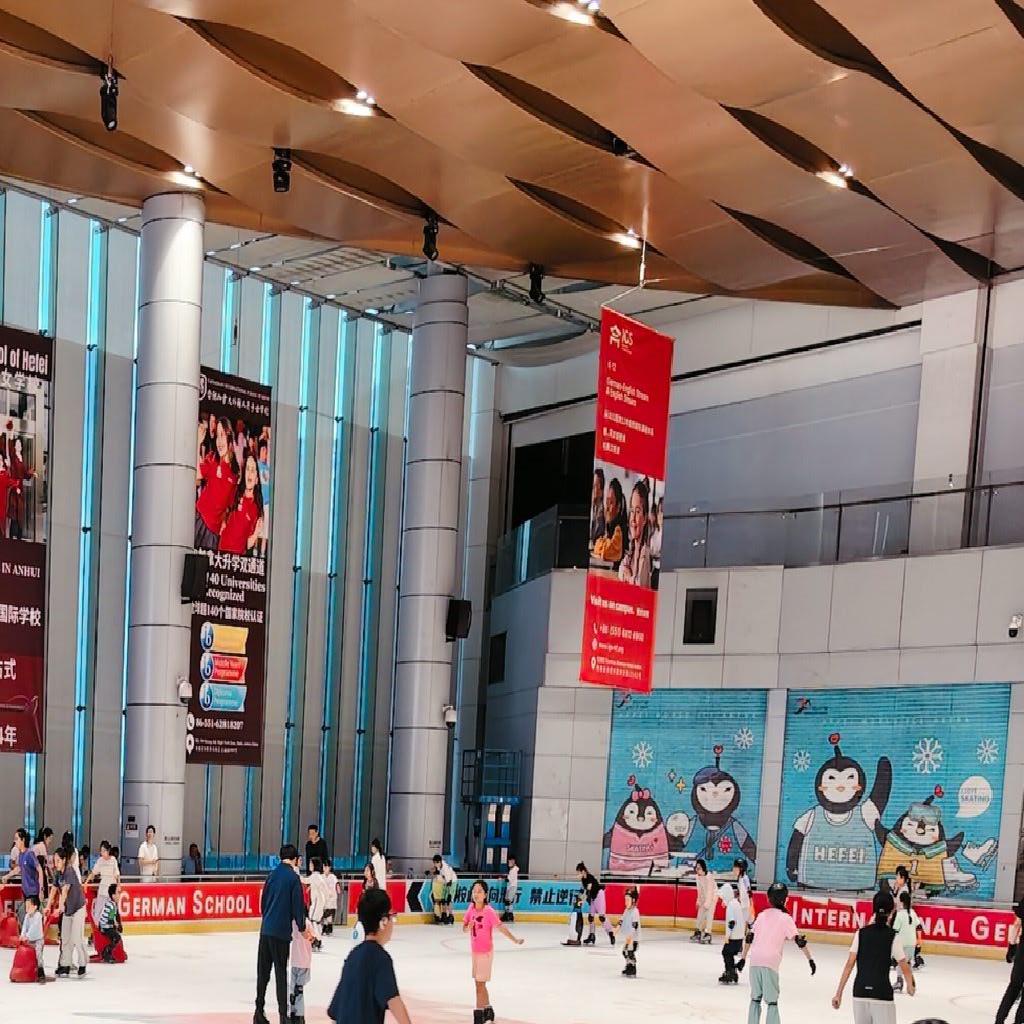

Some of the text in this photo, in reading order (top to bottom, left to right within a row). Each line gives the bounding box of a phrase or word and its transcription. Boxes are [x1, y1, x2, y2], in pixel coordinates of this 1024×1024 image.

[10, 347, 20, 369] of
[22, 350, 49, 376] Hefei
[1, 562, 12, 574] IN
[12, 564, 41, 579] ANHUI
[206, 587, 245, 603] ecognized
[814, 845, 866, 865] HEFEI
[118, 889, 253, 918] GERMAN SCHOOL
[793, 901, 959, 938] INTERNNAL
